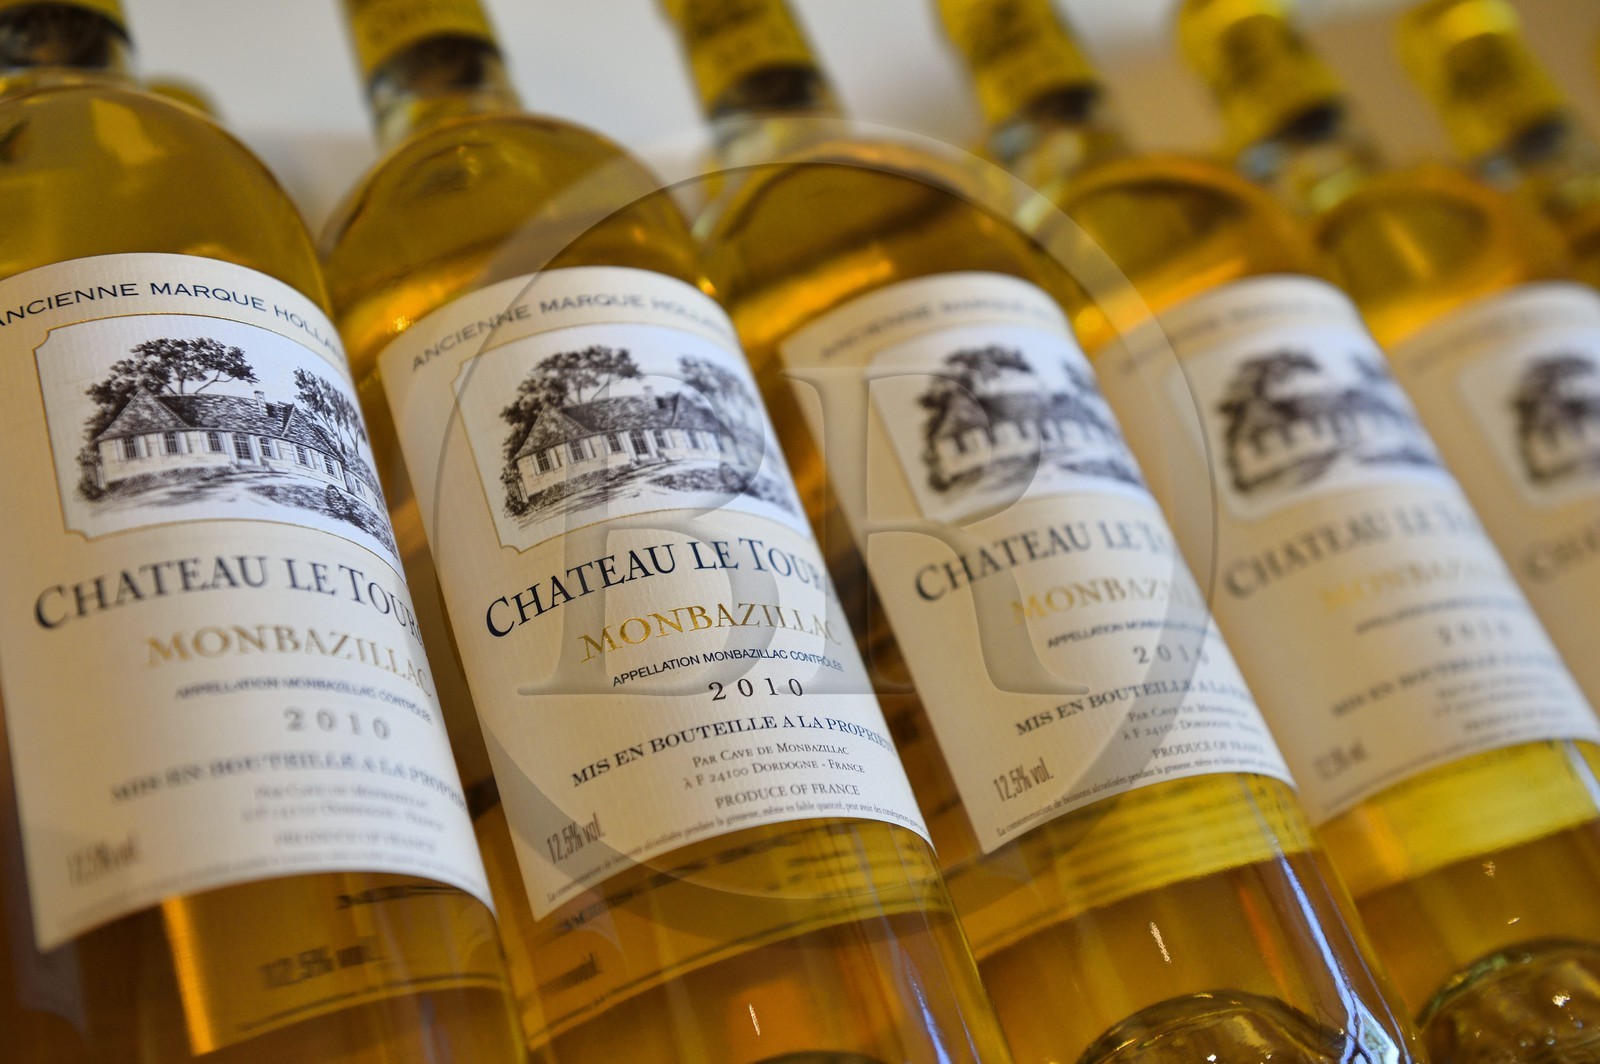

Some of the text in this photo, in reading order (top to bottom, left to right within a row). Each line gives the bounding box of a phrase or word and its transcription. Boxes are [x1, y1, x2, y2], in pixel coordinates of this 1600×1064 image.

[149, 282, 267, 313] MARQUE
[411, 304, 532, 373] ANCIENNE
[540, 293, 646, 316] MARQUE
[914, 522, 1093, 603] CHATEAU
[1097, 521, 1137, 551] LE
[33, 555, 268, 631] CHATEAU
[283, 558, 337, 597] LE
[485, 543, 677, 638] CHATEAU
[687, 540, 739, 571] LE
[576, 602, 842, 663] MONBAZILLAC
[148, 624, 432, 698] MONBAZILLAC
[612, 655, 701, 687] APPELLATION
[703, 648, 788, 664] MONBAZILLAC
[708, 677, 804, 702] 2010
[1015, 712, 1054, 736] MIS
[1056, 699, 1084, 720] EN
[1088, 678, 1196, 709] BOUTEILLE
[283, 706, 392, 741] 2010
[572, 761, 612, 788] MIS
[615, 742, 646, 767] EN
[651, 715, 777, 754] BOUTEILLE
[783, 715, 796, 728] A
[797, 715, 823, 729] LA
[693, 742, 850, 769] PAR CAVE DE MONBAZILLAC
[696, 773, 705, 787] F
[711, 767, 750, 785] 24100
[752, 760, 819, 775] DORDOGNE
[828, 758, 866, 774] FRANCE
[1152, 742, 1211, 760] PRODUCE
[715, 783, 861, 809] PRODUCE OF FRANCE
[994, 756, 1055, 803] 12,5% vol.
[546, 811, 607, 865] 12,5% vol.
